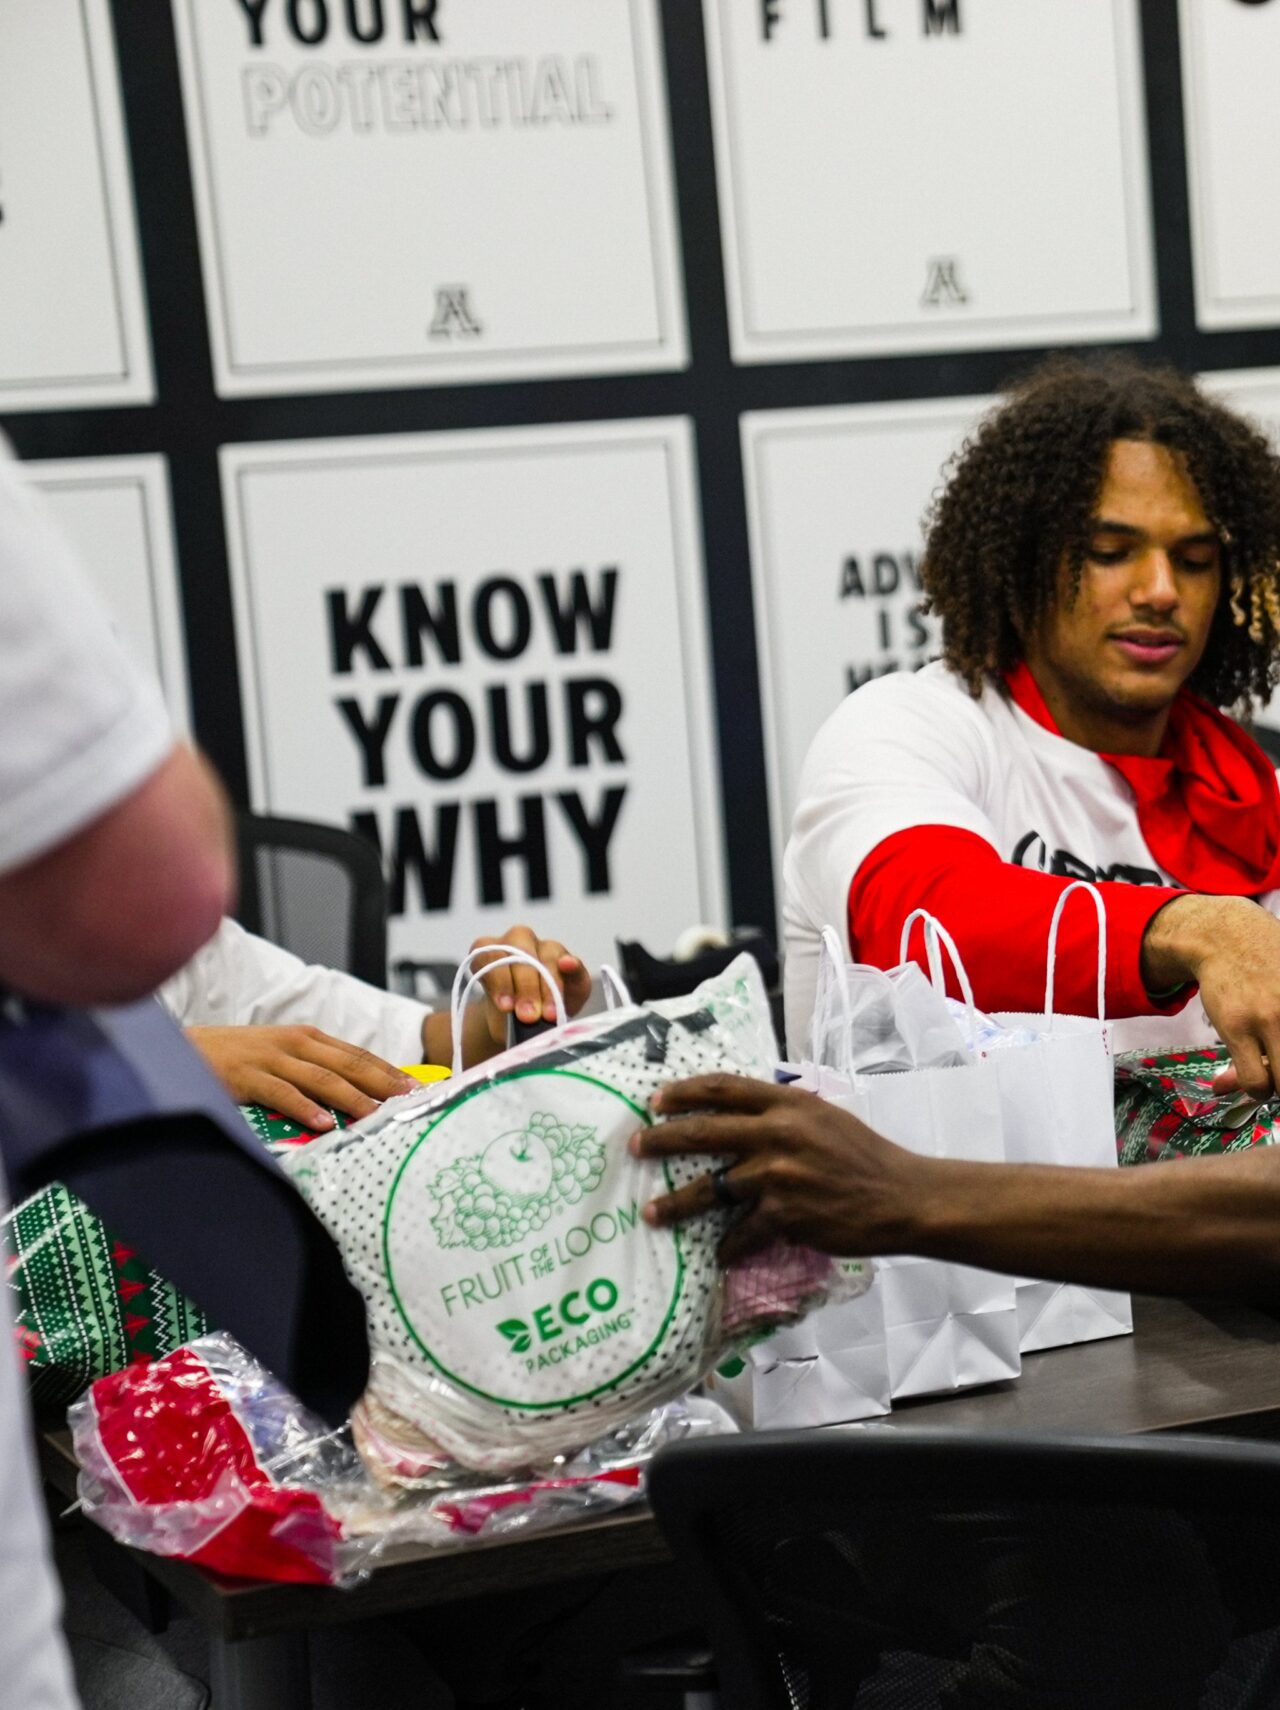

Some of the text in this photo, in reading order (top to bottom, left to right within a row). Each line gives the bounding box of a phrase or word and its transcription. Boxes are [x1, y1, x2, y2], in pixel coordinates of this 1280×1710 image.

[240, 0, 441, 47] YOUR
[759, 0, 964, 41] FILM
[240, 54, 614, 138] POTENTIAL
[839, 553, 926, 600] ADV
[322, 566, 619, 675] KNOW
[877, 608, 929, 651] IS
[334, 677, 627, 789] YOUR
[349, 782, 628, 918] WHY
[530, 1243, 549, 1262] OF
[530, 1258, 555, 1280] THE
[440, 1253, 525, 1317] FRUIT
[532, 1277, 618, 1343] ECO
